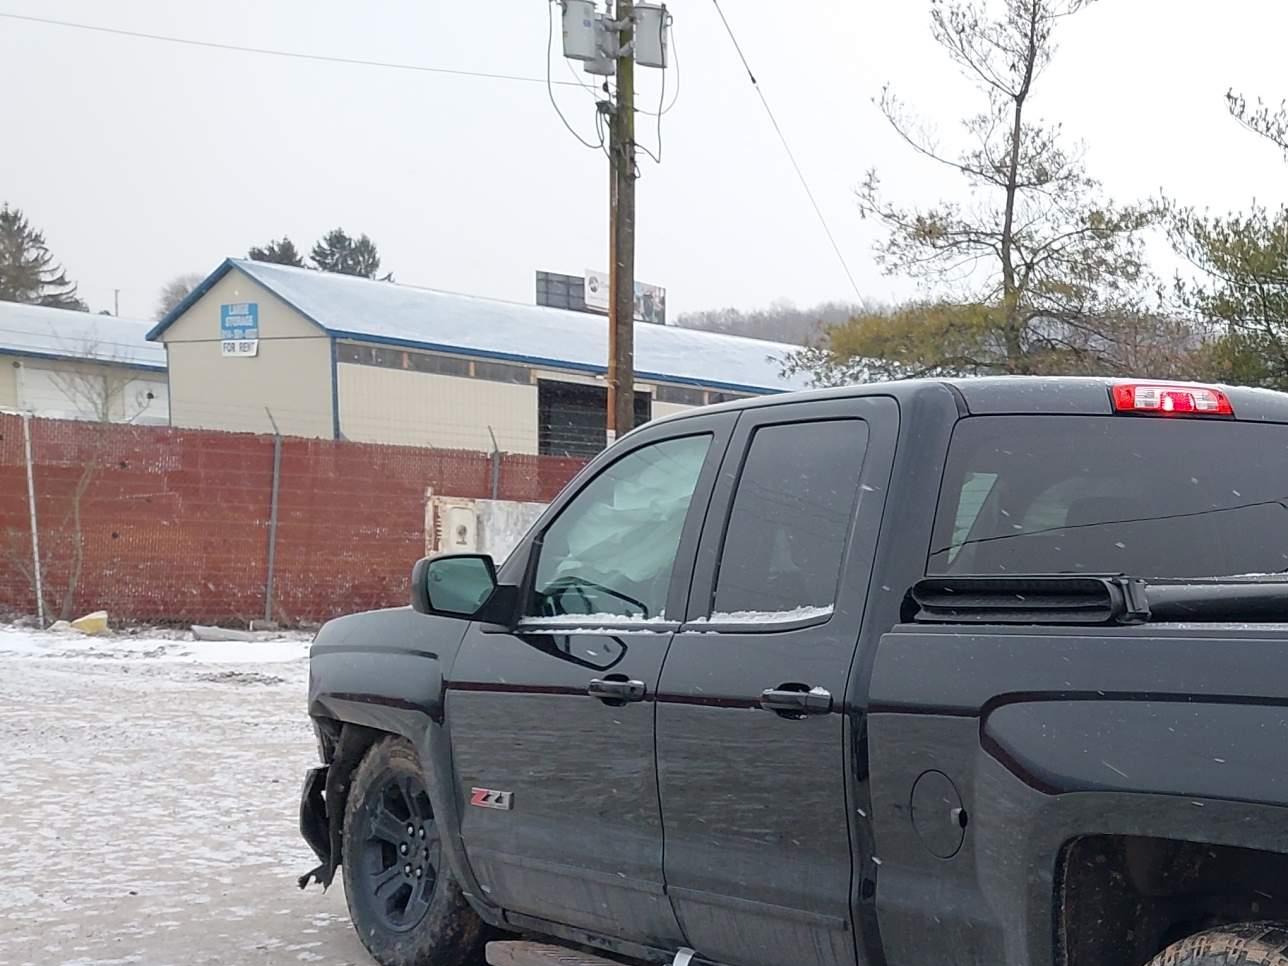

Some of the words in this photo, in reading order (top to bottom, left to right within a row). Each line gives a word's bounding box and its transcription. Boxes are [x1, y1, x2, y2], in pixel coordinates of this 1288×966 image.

[223, 342, 236, 352] FOR
[239, 342, 256, 352] RENT
[471, 786, 513, 811] Z71
